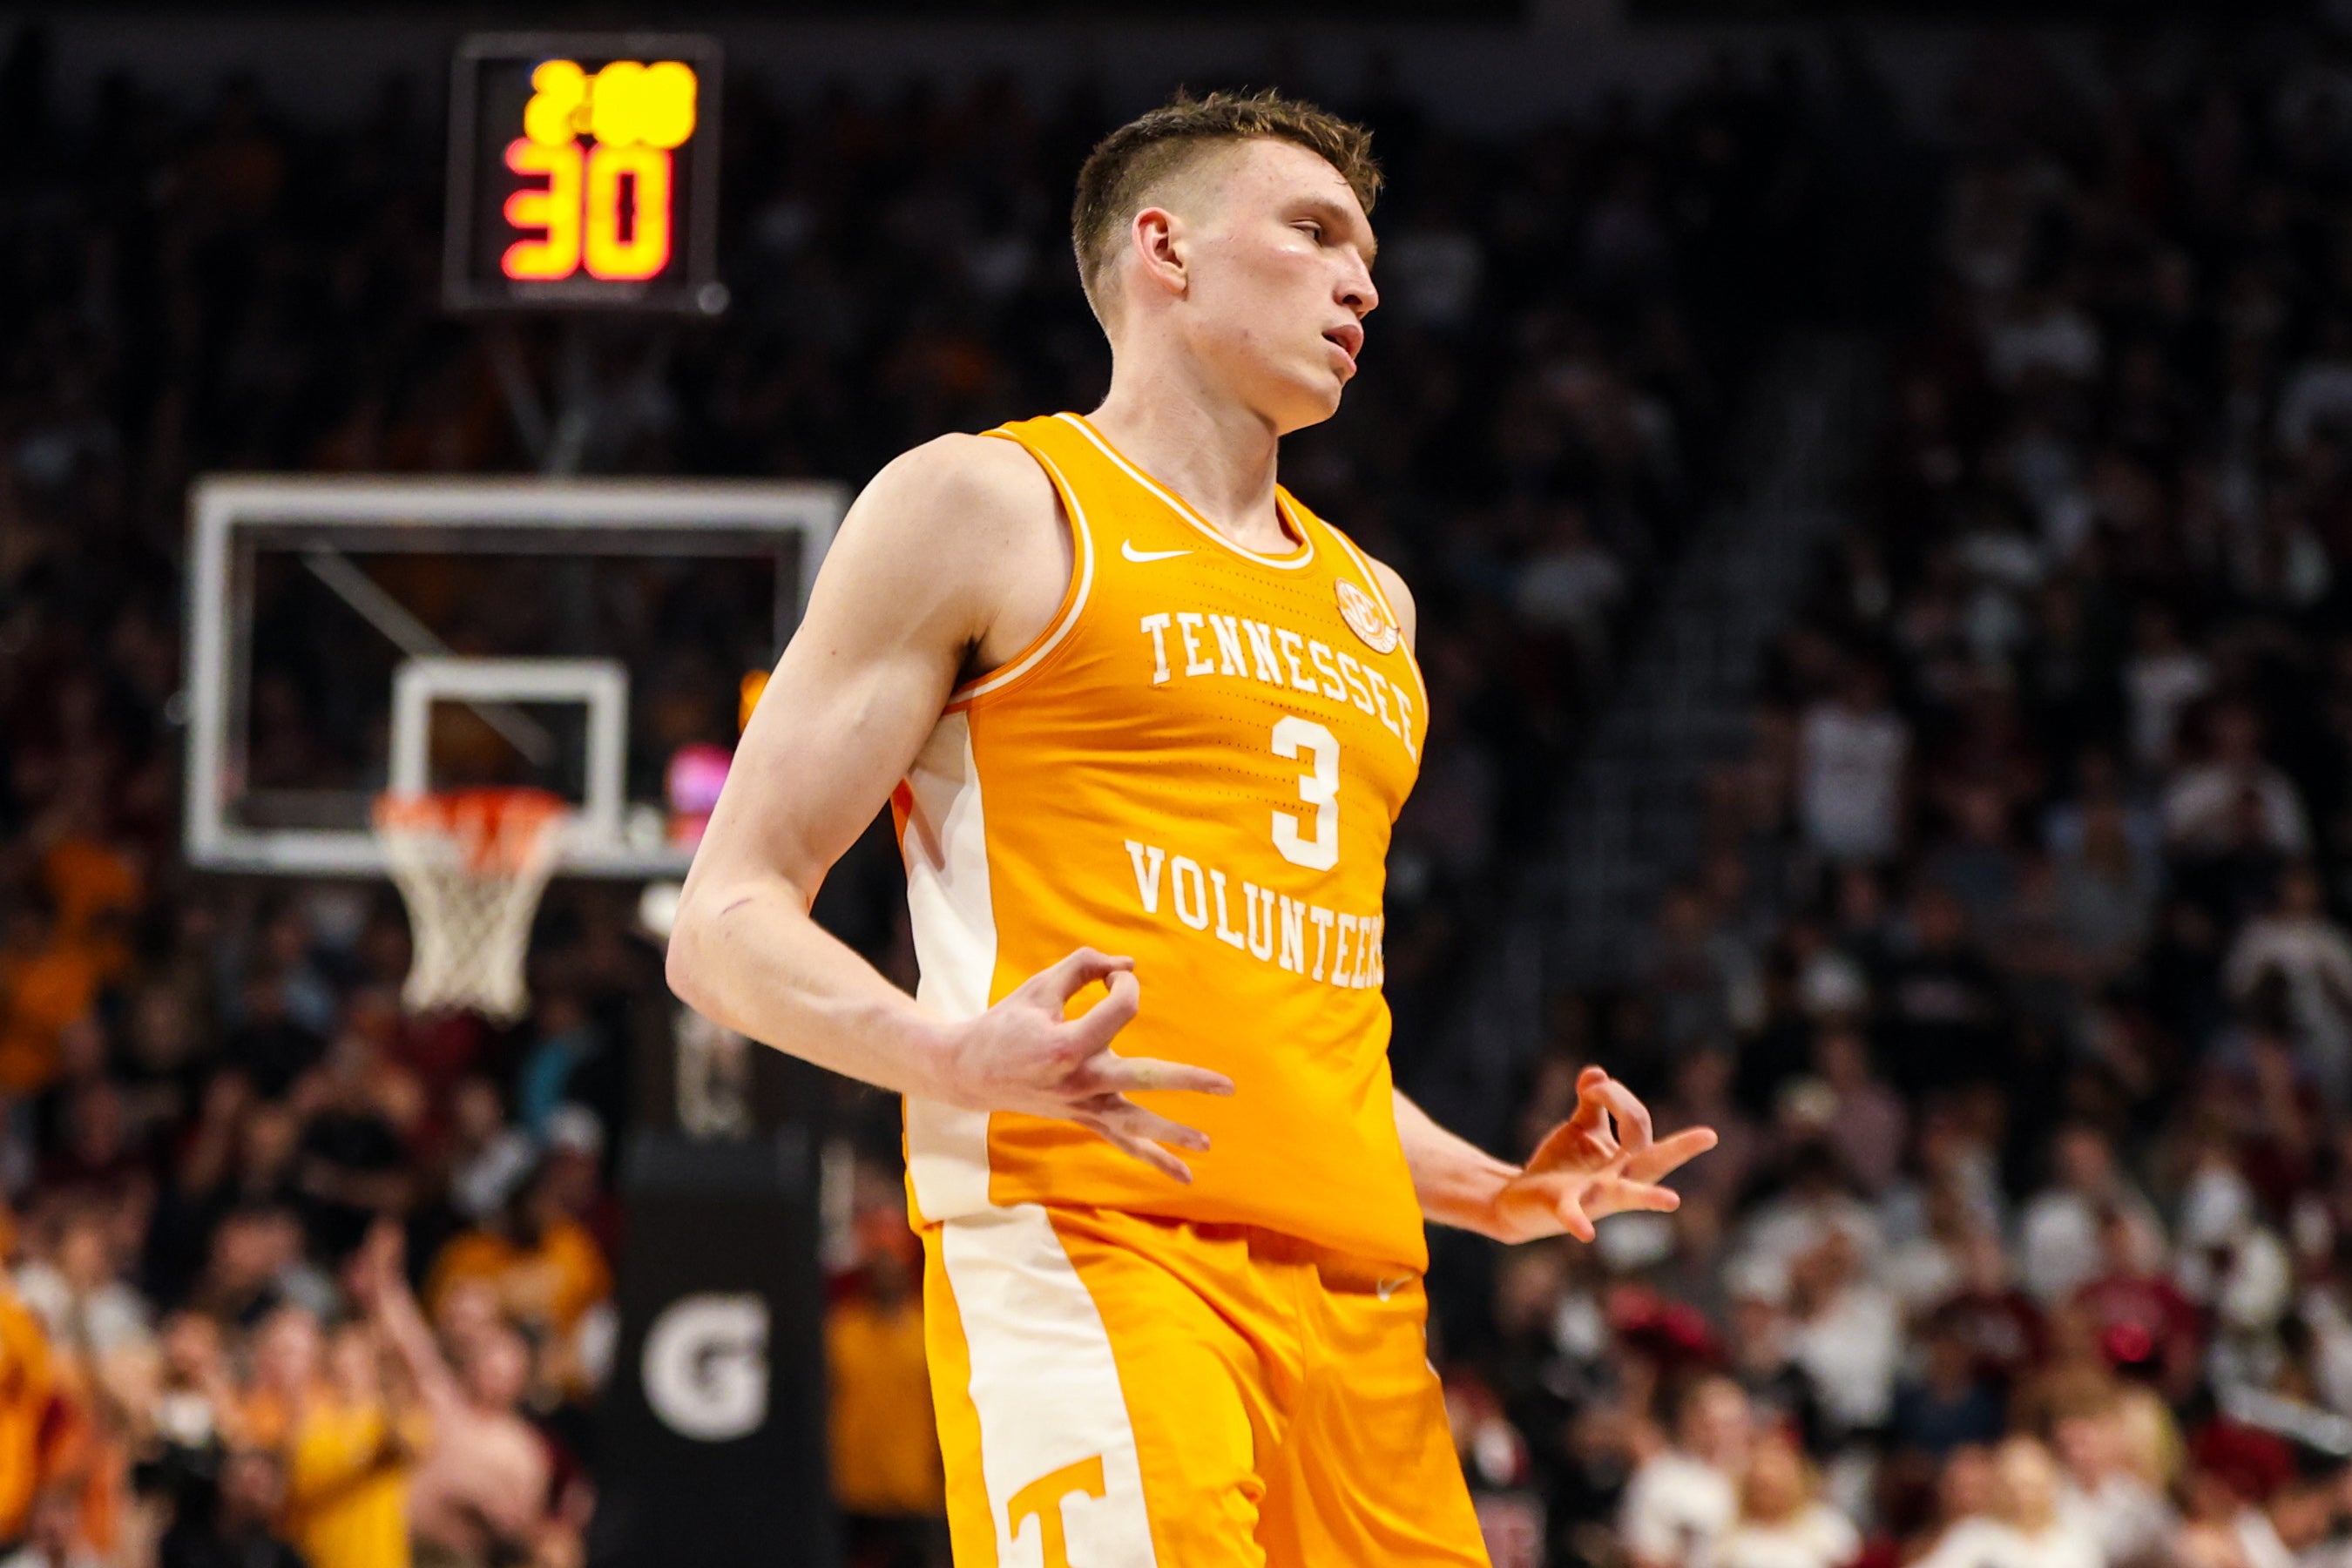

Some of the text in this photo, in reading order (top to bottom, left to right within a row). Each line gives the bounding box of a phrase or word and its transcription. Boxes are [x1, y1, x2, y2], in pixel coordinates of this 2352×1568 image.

[501, 136, 673, 280] 30
[1139, 612, 1417, 766] TENNESSEE
[1271, 714, 1341, 872] 3
[641, 1293, 771, 1440] G
